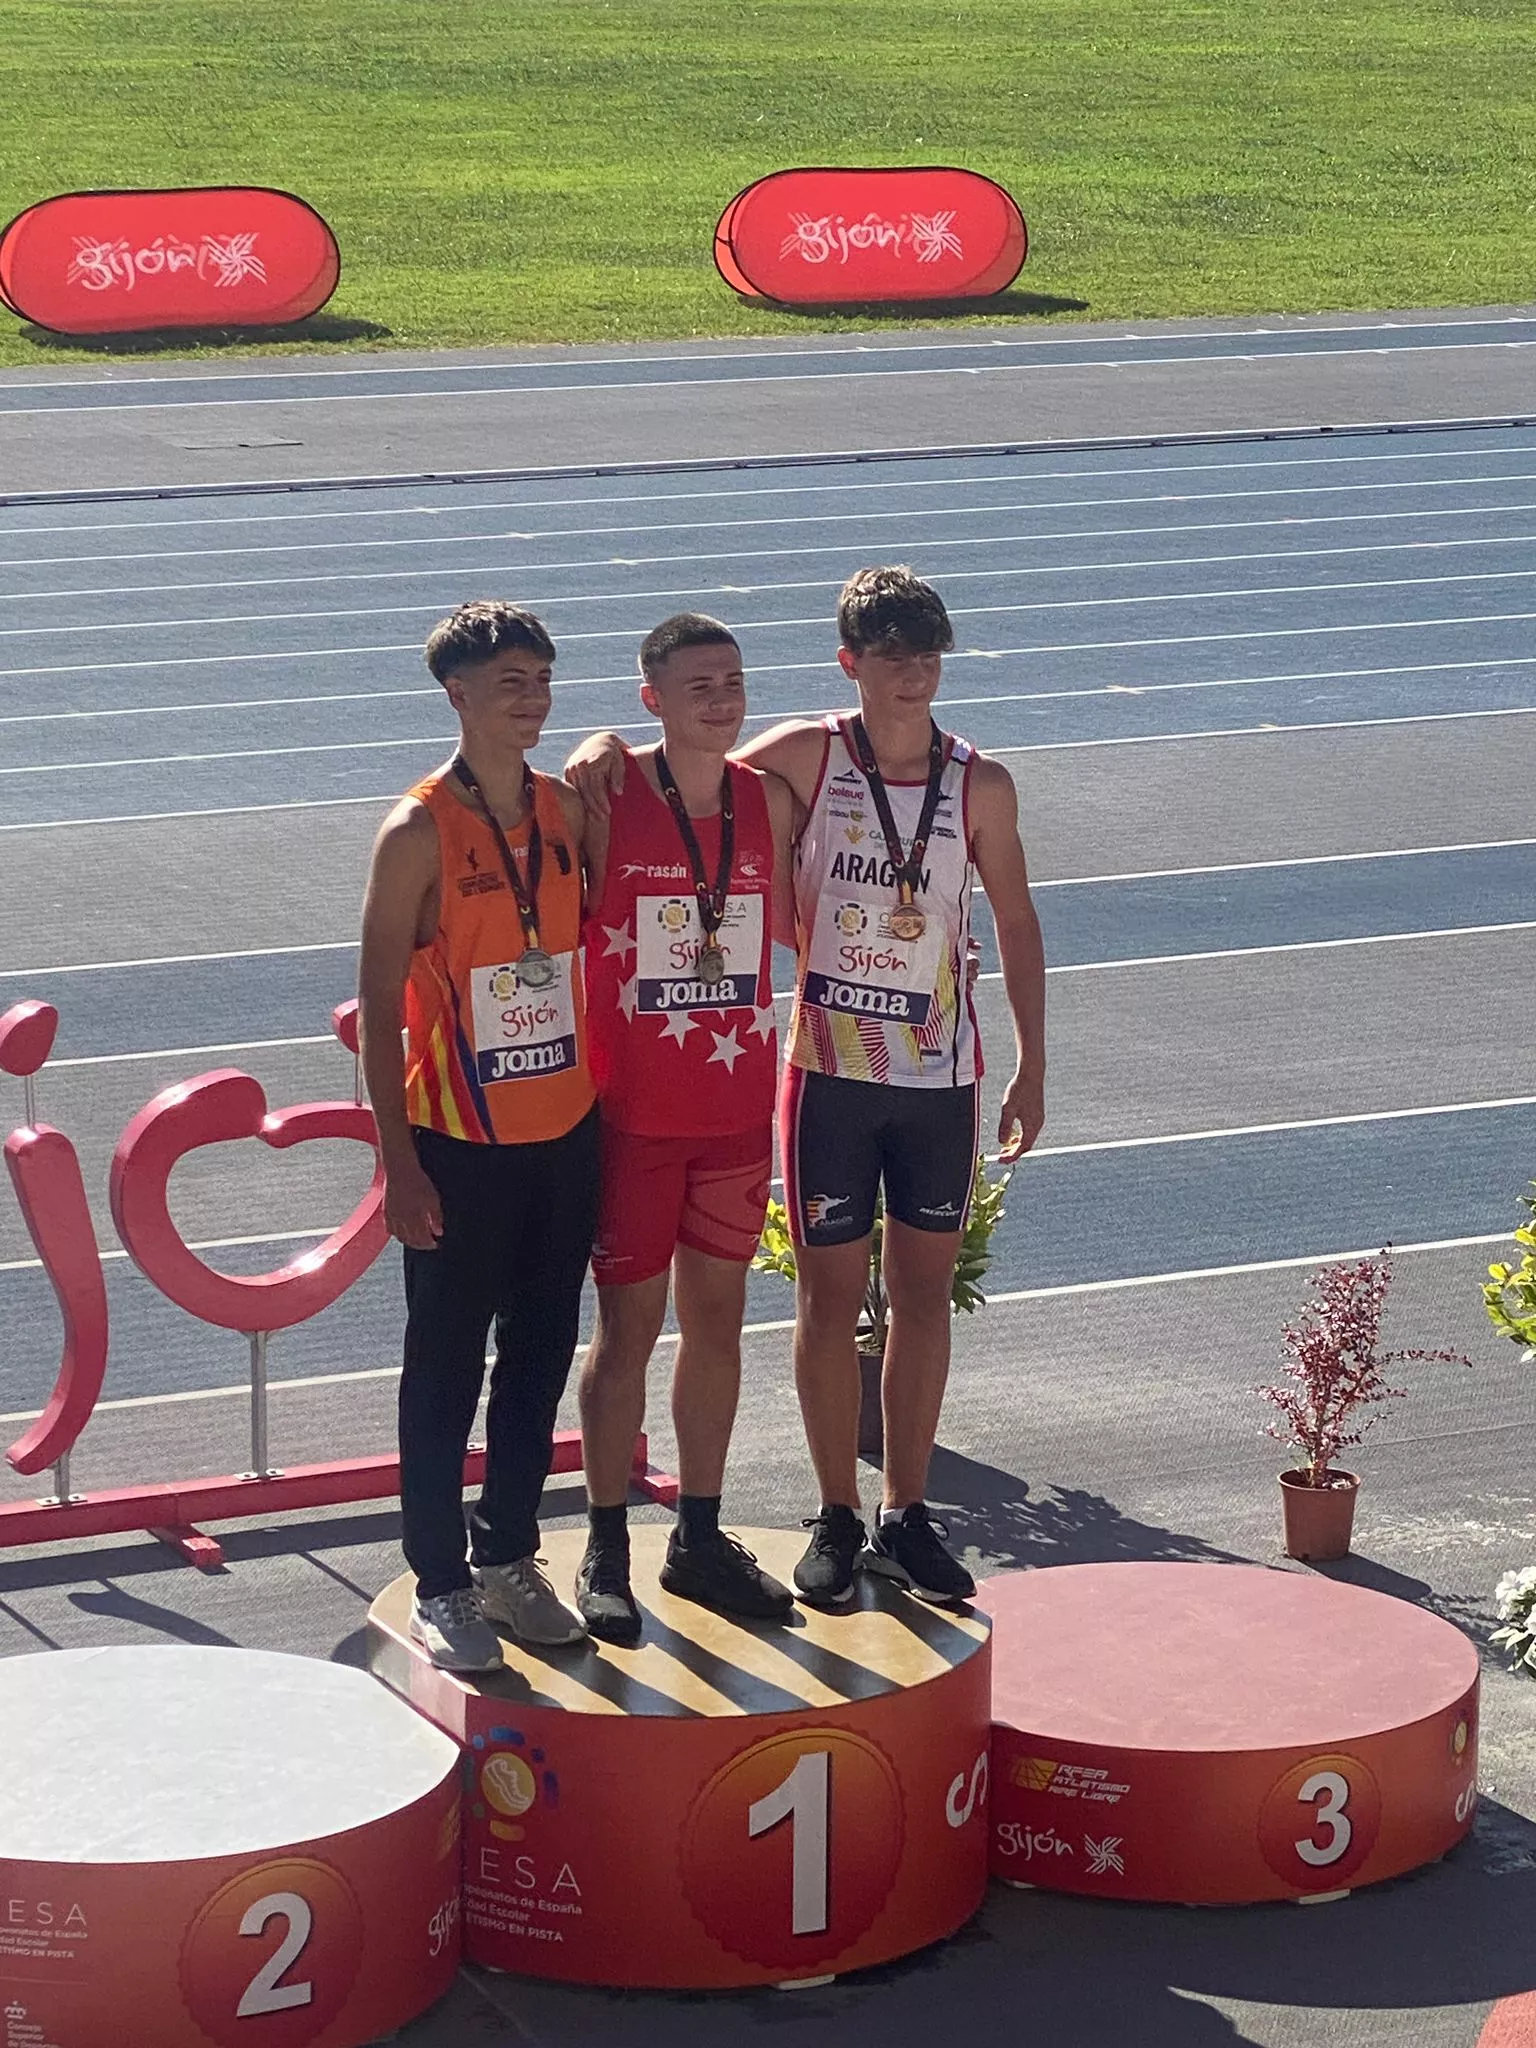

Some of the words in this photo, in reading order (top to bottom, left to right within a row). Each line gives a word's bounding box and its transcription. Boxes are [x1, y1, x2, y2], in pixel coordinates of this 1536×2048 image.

[830, 851, 931, 894] ARAGN
[838, 945, 908, 977] gijón
[501, 1000, 559, 1038] gijón
[1294, 1771, 1352, 1866] 3
[748, 1750, 833, 1936] 1
[997, 1823, 1074, 1862] gijón
[480, 1847, 582, 1897] ESA
[8, 1899, 88, 1926] ESA
[489, 1904, 532, 1922] Escolar
[520, 1898, 535, 1909] de
[538, 1899, 583, 1915] España
[508, 1924, 525, 1936] EN
[527, 1927, 564, 1943] PISTA
[236, 1892, 313, 2019] 2
